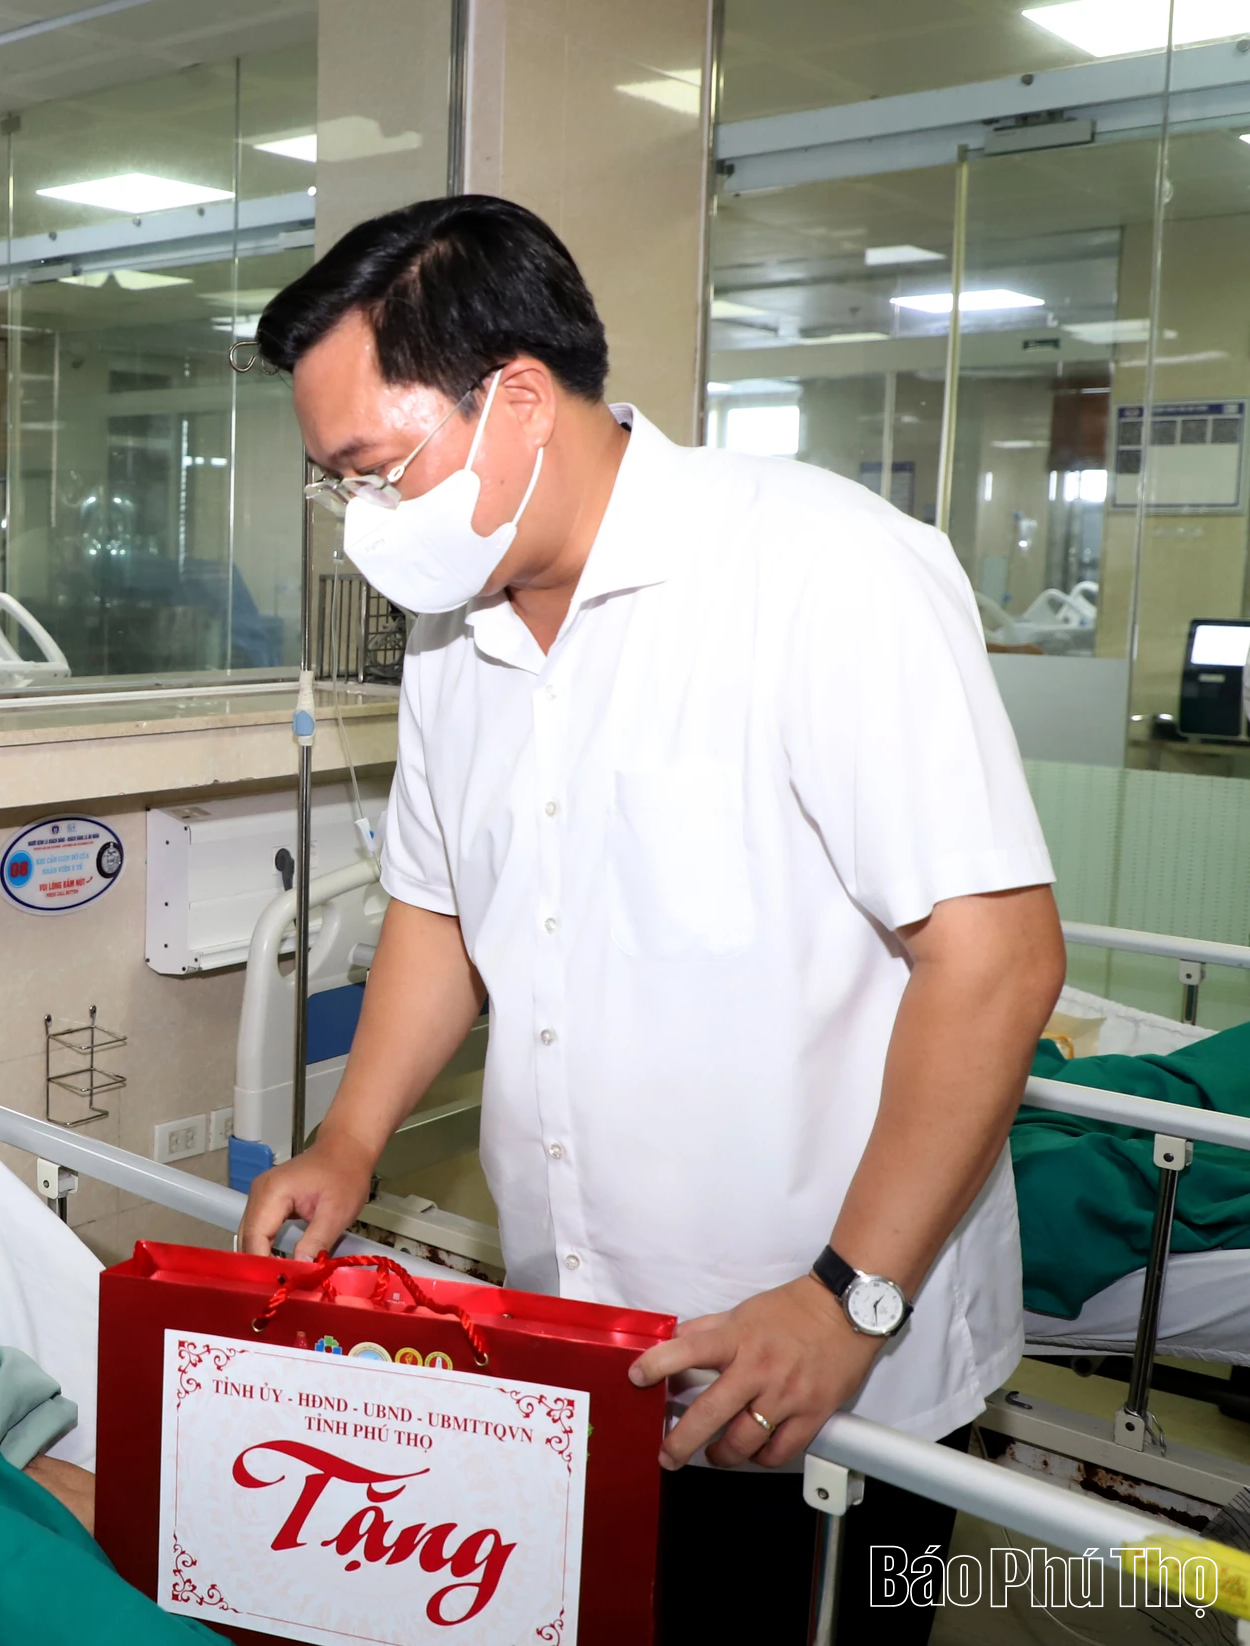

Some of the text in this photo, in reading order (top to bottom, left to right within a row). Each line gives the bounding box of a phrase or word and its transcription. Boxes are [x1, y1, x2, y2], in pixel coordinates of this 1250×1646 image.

[10, 861, 29, 878] 08
[212, 1376, 254, 1399] TỈNH
[259, 1382, 283, 1403] ỦY
[297, 1391, 349, 1413] HĐND
[363, 1402, 413, 1423] UBND
[427, 1411, 534, 1444] UBMTTQVN
[304, 1413, 433, 1453] TỈNH PHÚ THỌ
[232, 1439, 518, 1627] Tặng
